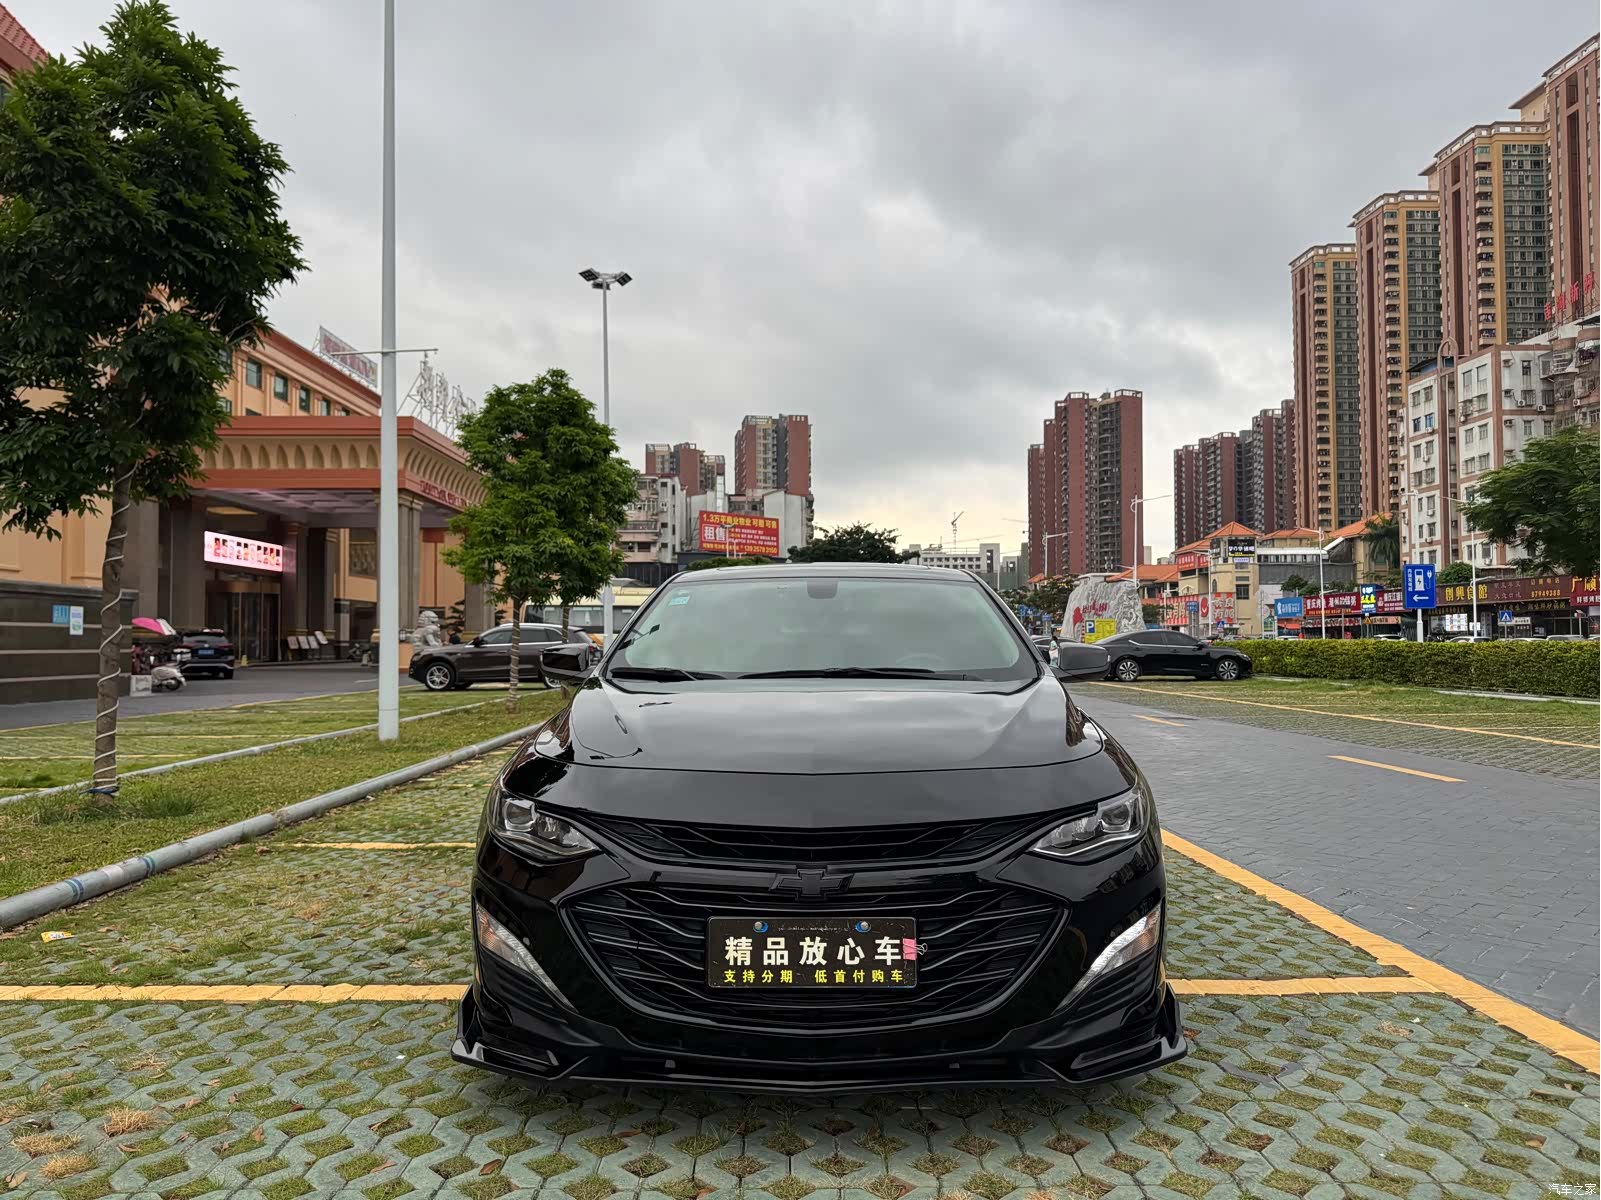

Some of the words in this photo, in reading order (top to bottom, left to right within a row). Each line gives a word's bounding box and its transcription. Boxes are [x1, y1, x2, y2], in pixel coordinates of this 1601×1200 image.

[704, 526, 725, 541] 租售
[1086, 621, 1095, 633] P
[725, 936, 901, 966] 精品放心车
[724, 969, 793, 983] 支持分期
[814, 969, 904, 983] 低首付购车
